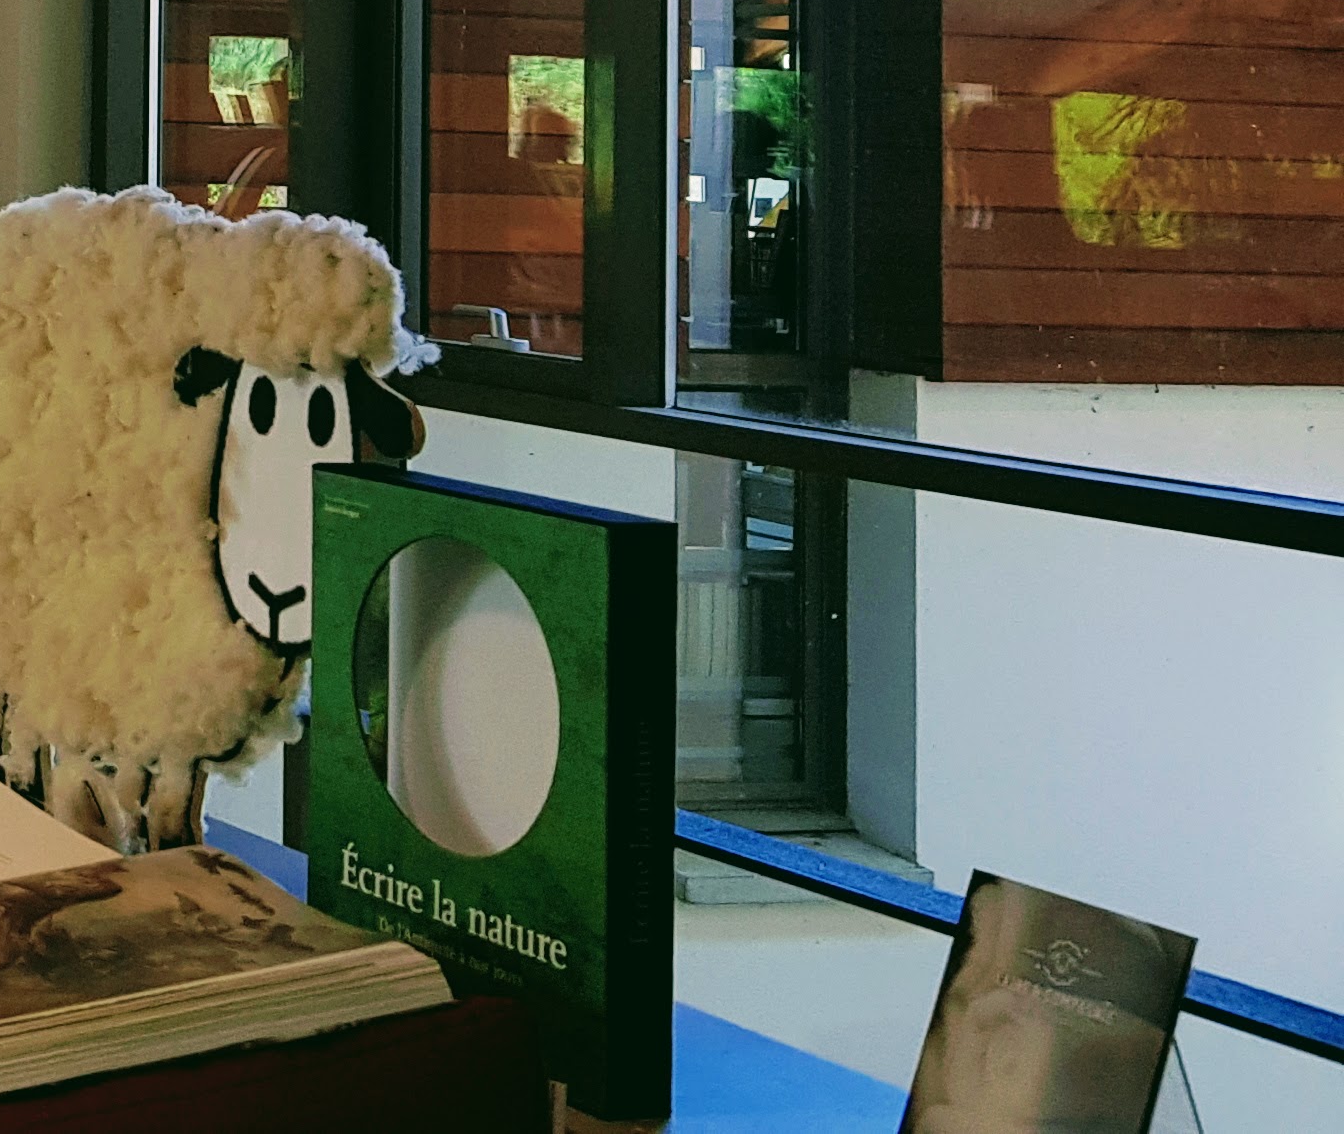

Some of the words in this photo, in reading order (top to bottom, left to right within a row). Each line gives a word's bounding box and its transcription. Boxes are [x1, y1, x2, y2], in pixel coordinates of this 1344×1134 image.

[340, 841, 424, 914] Écrire
[431, 878, 457, 928] la
[468, 906, 568, 970] nature
